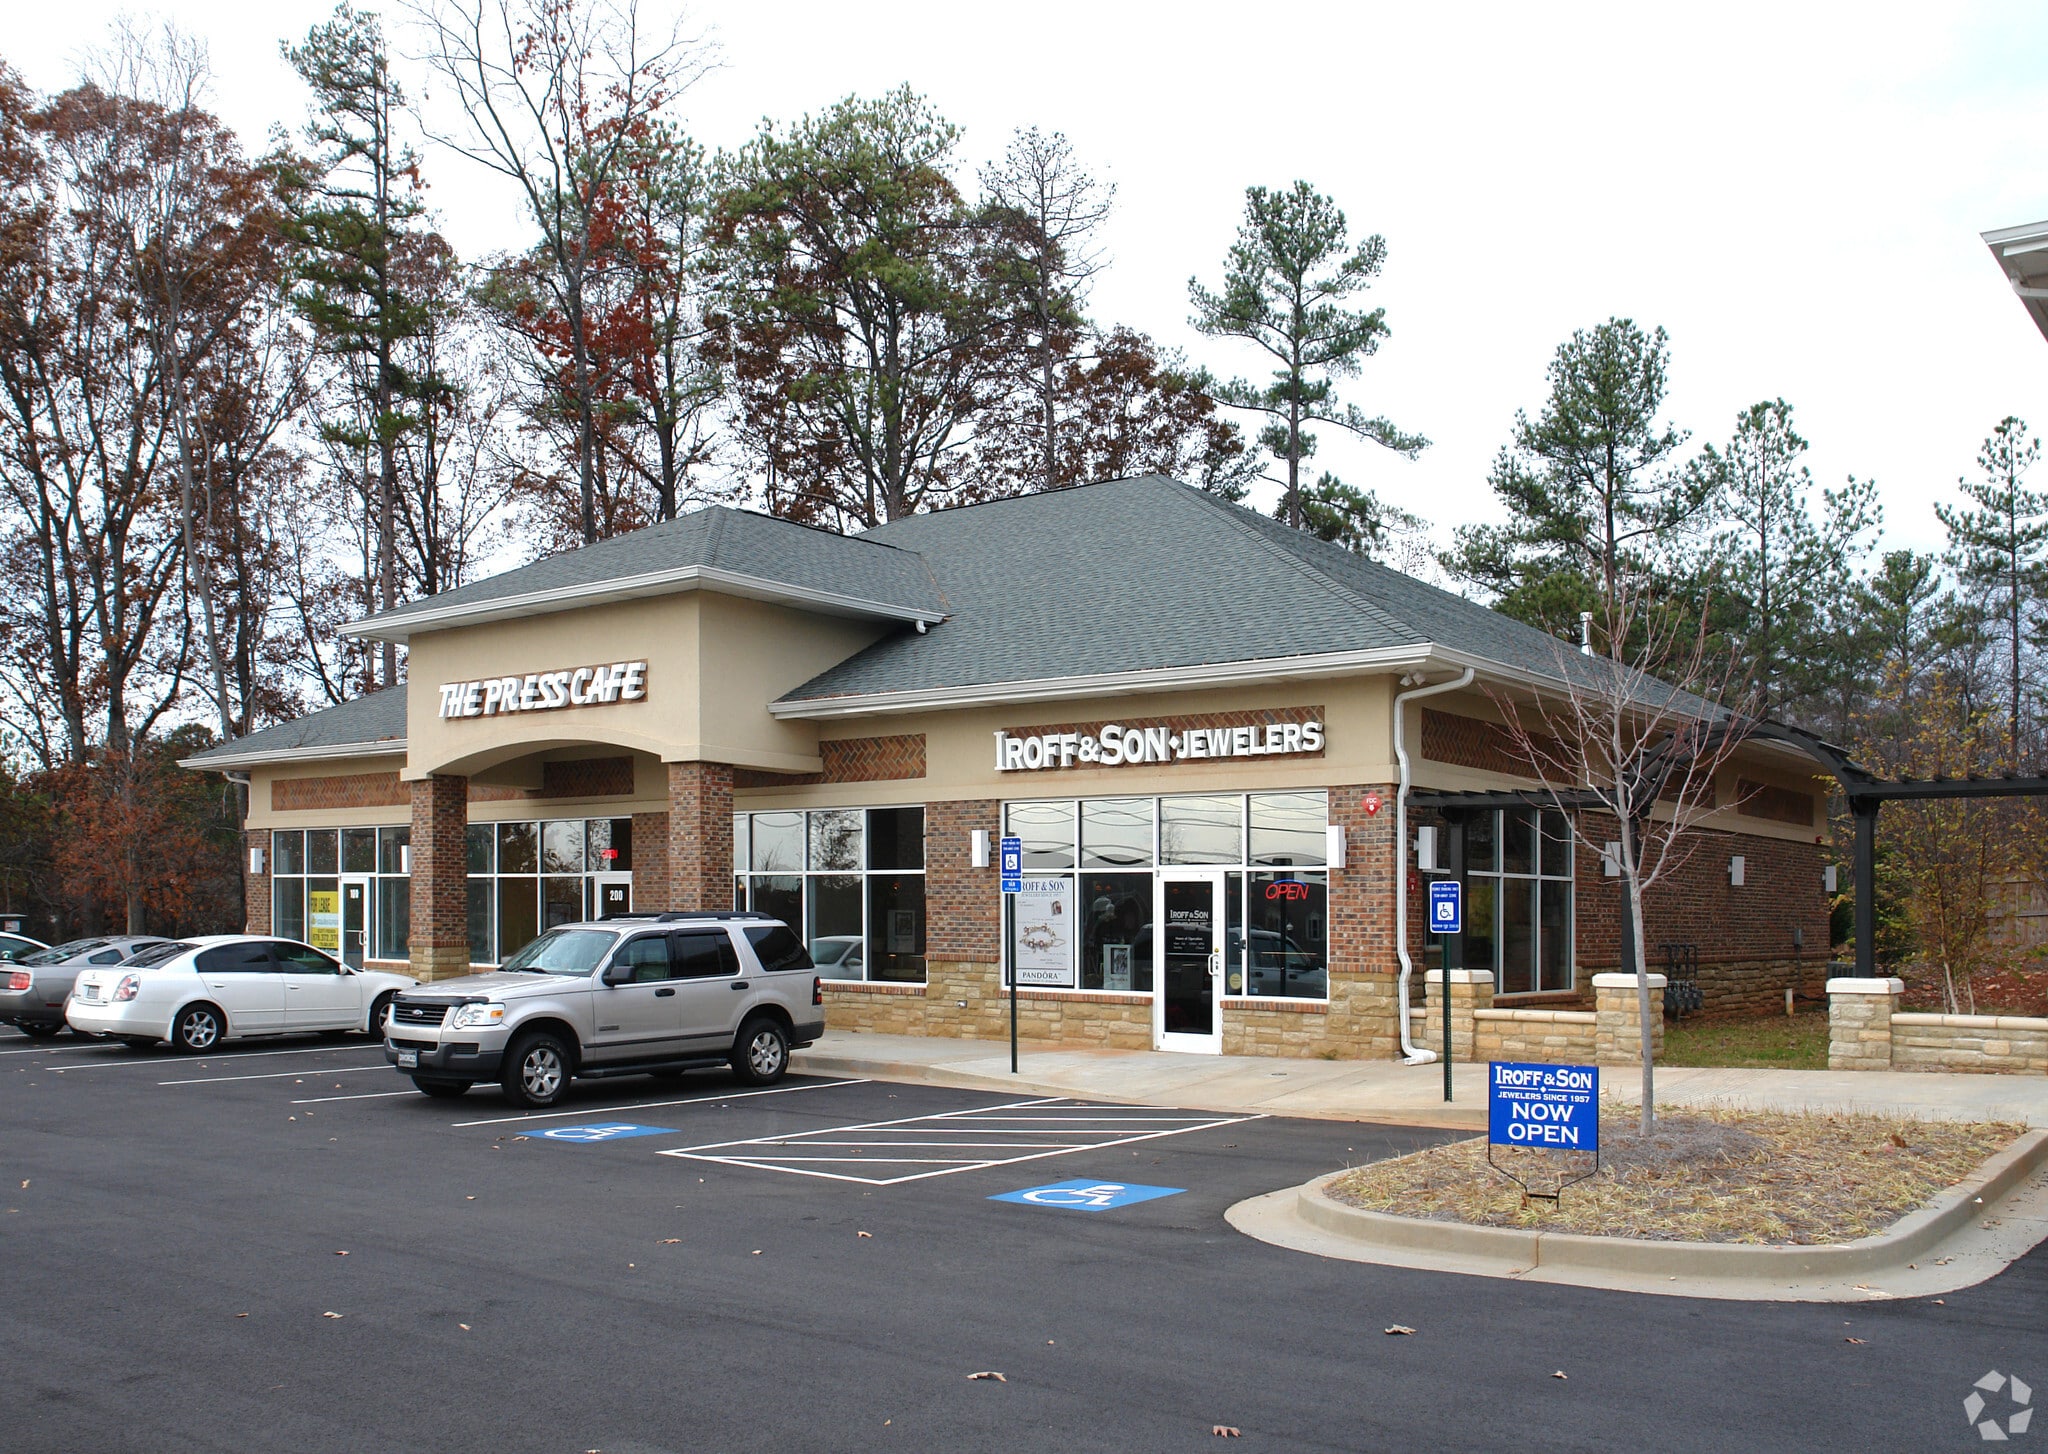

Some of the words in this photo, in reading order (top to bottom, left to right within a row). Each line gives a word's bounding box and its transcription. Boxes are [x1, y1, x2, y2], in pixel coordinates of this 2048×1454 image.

[439, 682, 482, 717] THE
[483, 671, 571, 714] PRESS
[570, 662, 647, 705] CAFE
[1175, 722, 1324, 758] JEWELERS
[1022, 881, 1040, 891] ROFF
[1041, 880, 1047, 891] &
[1049, 880, 1065, 891] SON
[1265, 884, 1310, 900] OPEN
[609, 890, 623, 901] 200
[1498, 1091, 1541, 1101] JEWELERS
[1543, 1093, 1568, 1102] SINCE
[1570, 1095, 1590, 1103] 1957
[1512, 1102, 1574, 1122] NOW
[1507, 1122, 1579, 1144] OPEN
